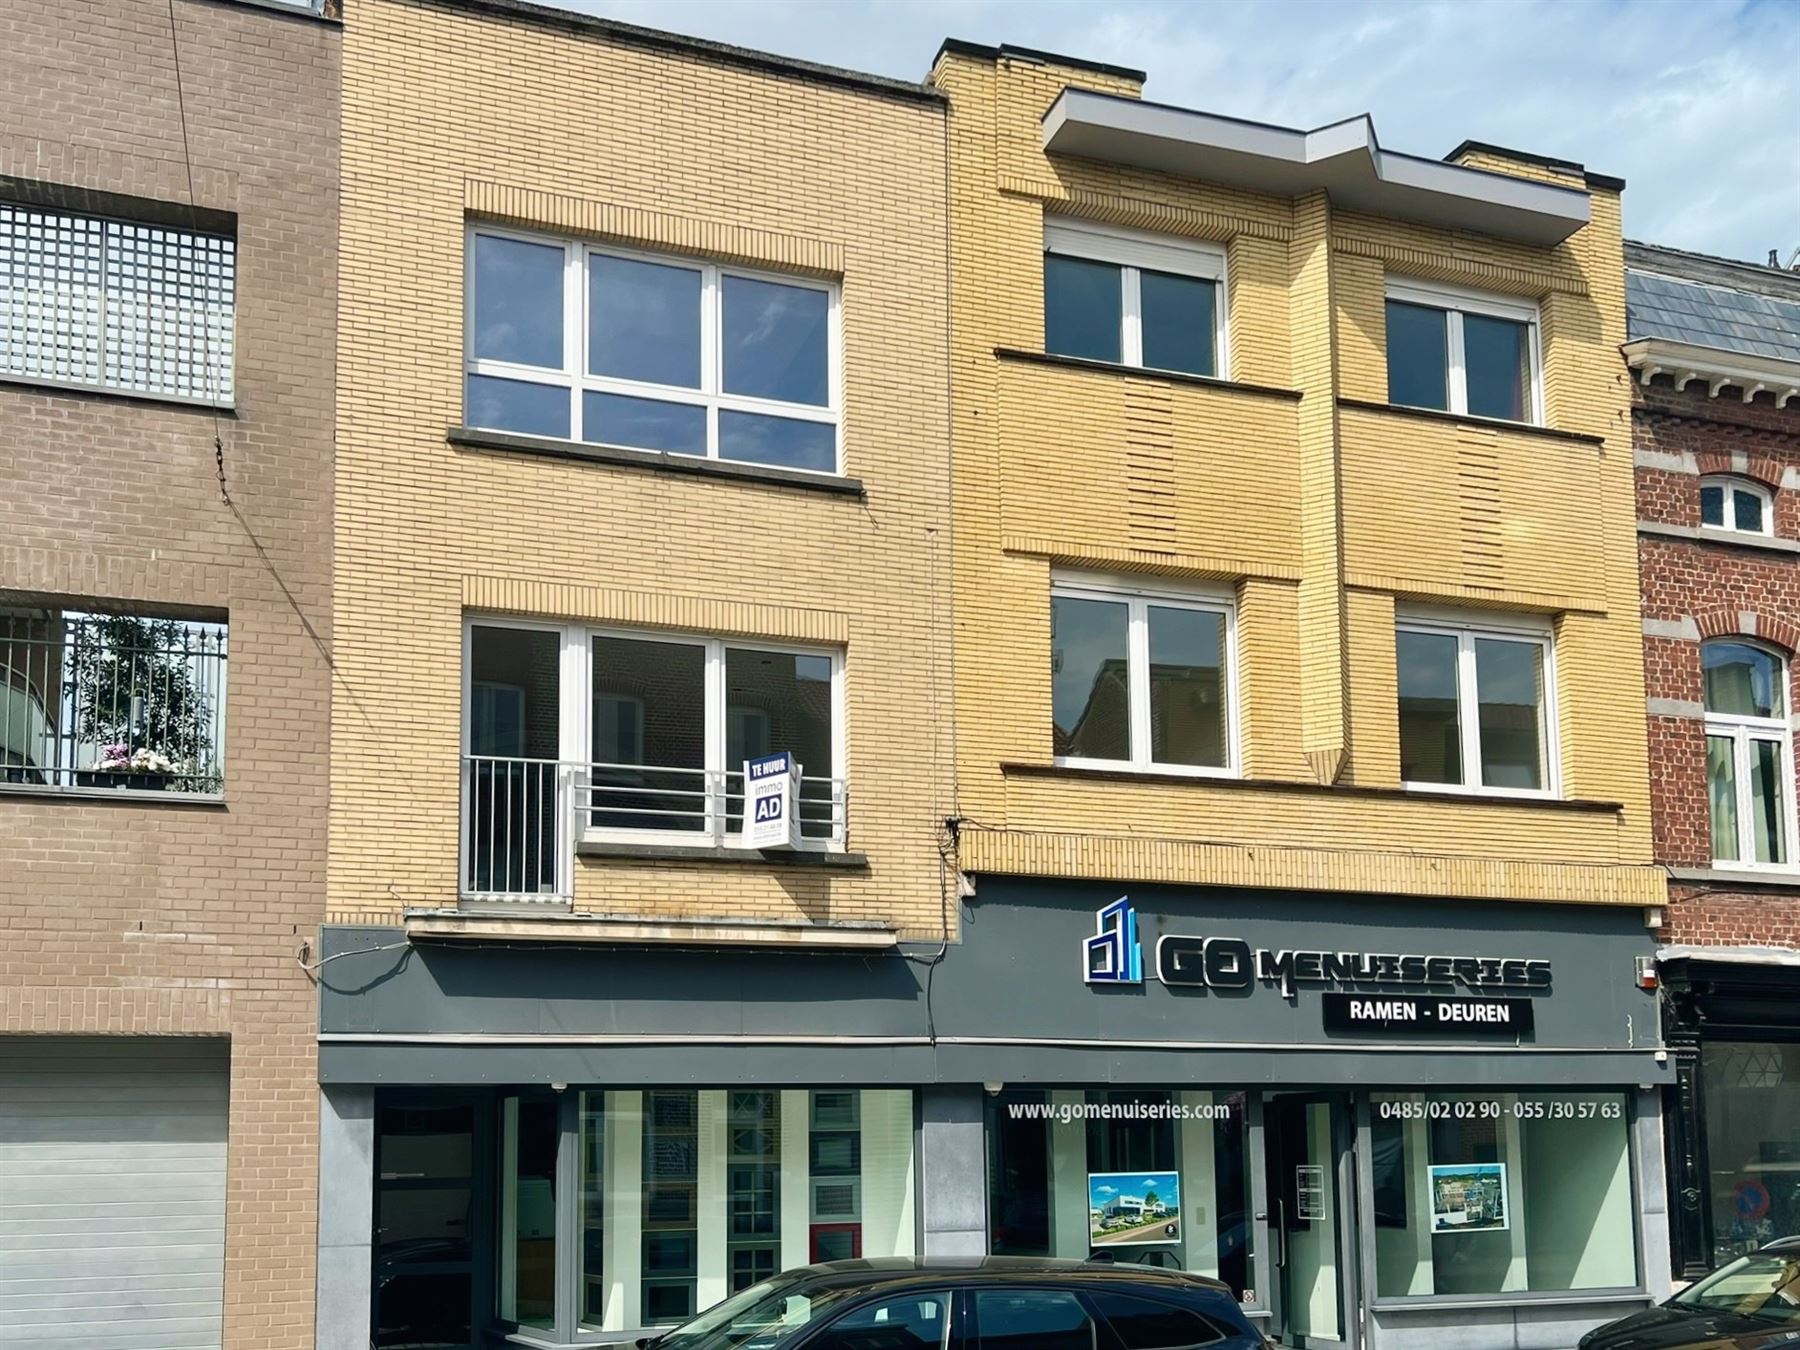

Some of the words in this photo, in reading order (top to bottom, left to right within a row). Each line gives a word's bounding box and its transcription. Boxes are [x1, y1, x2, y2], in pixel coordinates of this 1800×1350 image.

[752, 764, 762, 777] TE
[763, 759, 786, 775] HUUR
[755, 781, 783, 796] immo
[757, 797, 780, 820] AD
[1156, 935, 1250, 987] GO
[1256, 949, 1552, 997] MENUISERIES
[1350, 1001, 1417, 1021] RAMEN
[1438, 1003, 1510, 1022] DEUREN
[1008, 1099, 1230, 1123] www.gomenuiseries.com
[1379, 1101, 1451, 1119] 0485/02
[1454, 1101, 1476, 1119] 02
[1479, 1101, 1500, 1119] 90
[1513, 1102, 1544, 1119] 055
[1547, 1102, 1574, 1119] /30
[1578, 1102, 1597, 1119] 57
[1601, 1102, 1621, 1119] 63
